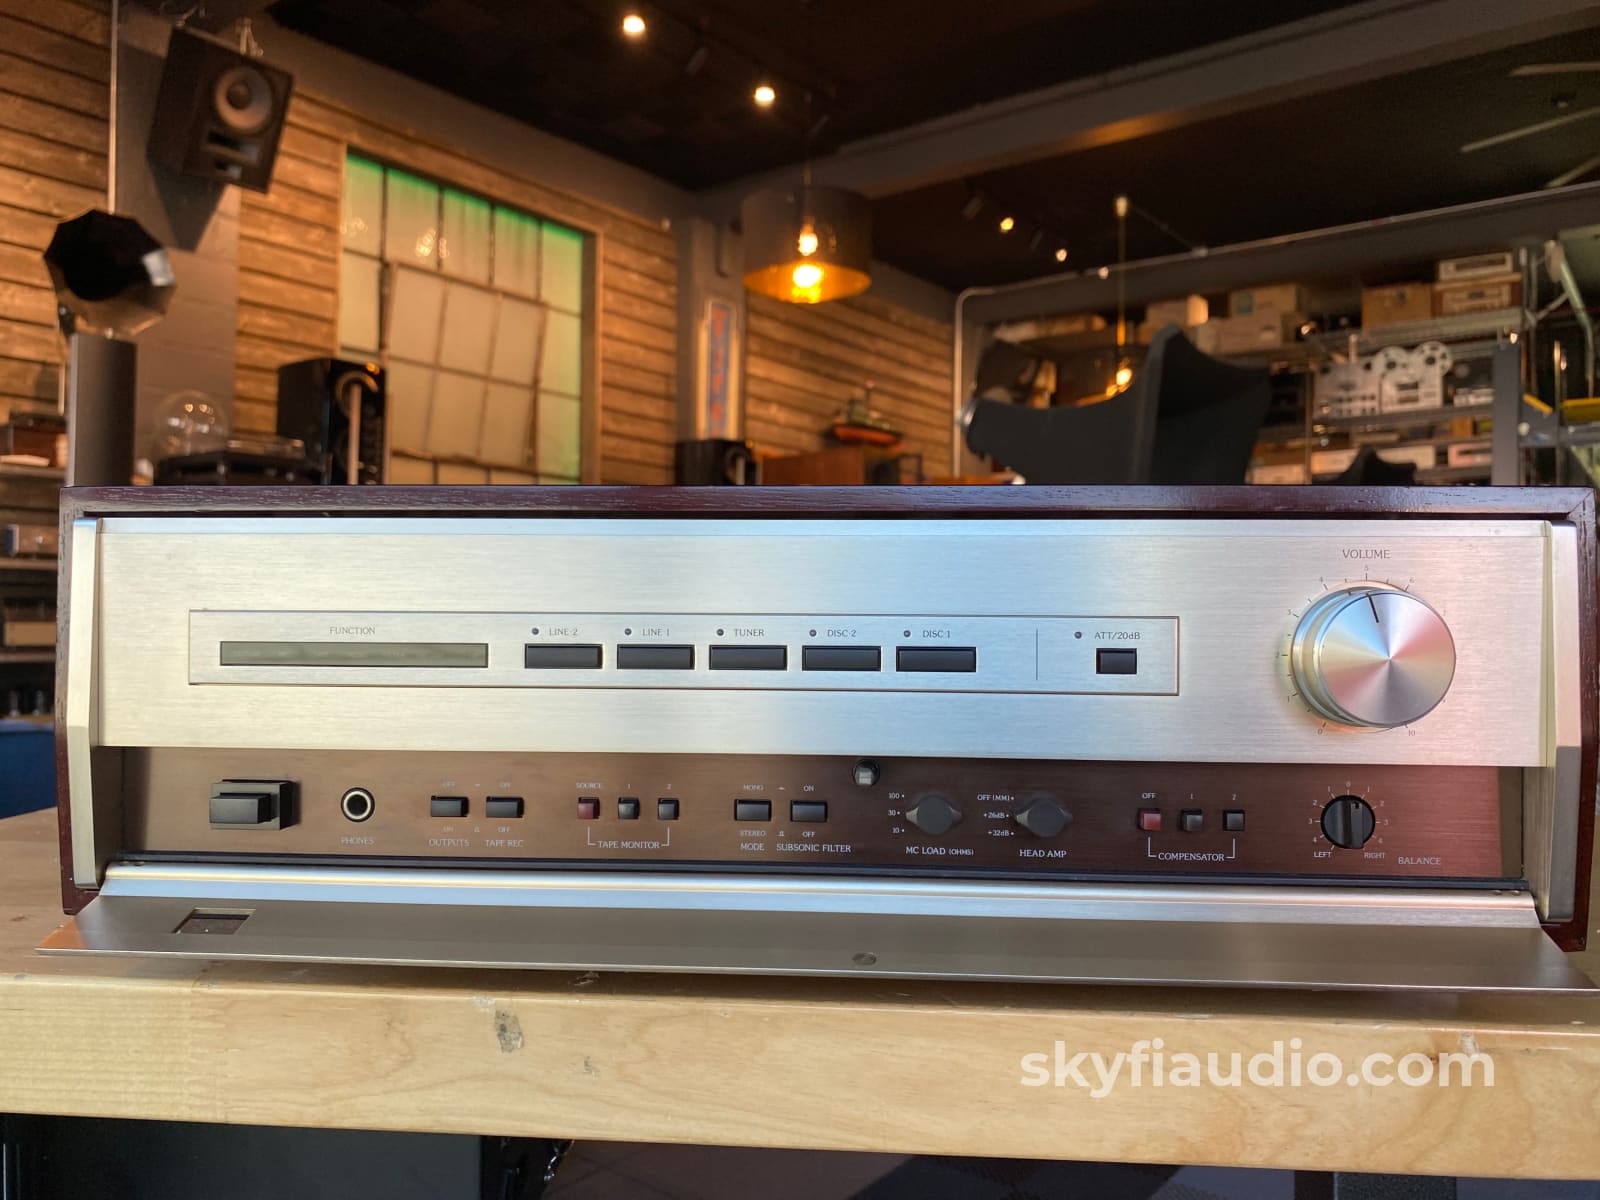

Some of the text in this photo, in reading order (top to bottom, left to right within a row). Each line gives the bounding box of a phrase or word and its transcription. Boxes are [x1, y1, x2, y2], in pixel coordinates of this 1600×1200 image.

[1341, 548, 1391, 560] VOLUME
[329, 625, 376, 635] FUNCTION
[549, 626, 569, 637] LINE
[642, 627, 662, 638] LINE
[734, 627, 765, 638] TUNER
[827, 629, 849, 638] DISC
[922, 630, 944, 639] DISC
[1094, 631, 1141, 640] ATT/20dB
[576, 782, 602, 790] SOURCE
[743, 784, 764, 792] MONO
[803, 785, 815, 793] ON
[889, 792, 900, 800] 100
[1141, 792, 1157, 800] OFF
[740, 829, 767, 837] STEREO
[340, 836, 375, 846] PHONES
[428, 838, 470, 848] OUTPUTS
[485, 839, 524, 849] TAPE REC
[598, 840, 660, 850] TAPE MONITOR
[740, 842, 765, 852] MODE
[776, 843, 852, 853] SUBSONIC FILTER
[905, 846, 919, 855] MC
[922, 846, 946, 856] LOAD
[1019, 849, 1067, 859] HEAD AMP
[1158, 852, 1225, 862] COMPENSATOR
[1313, 851, 1331, 859] LEFT
[1398, 856, 1441, 866] BALANCE
